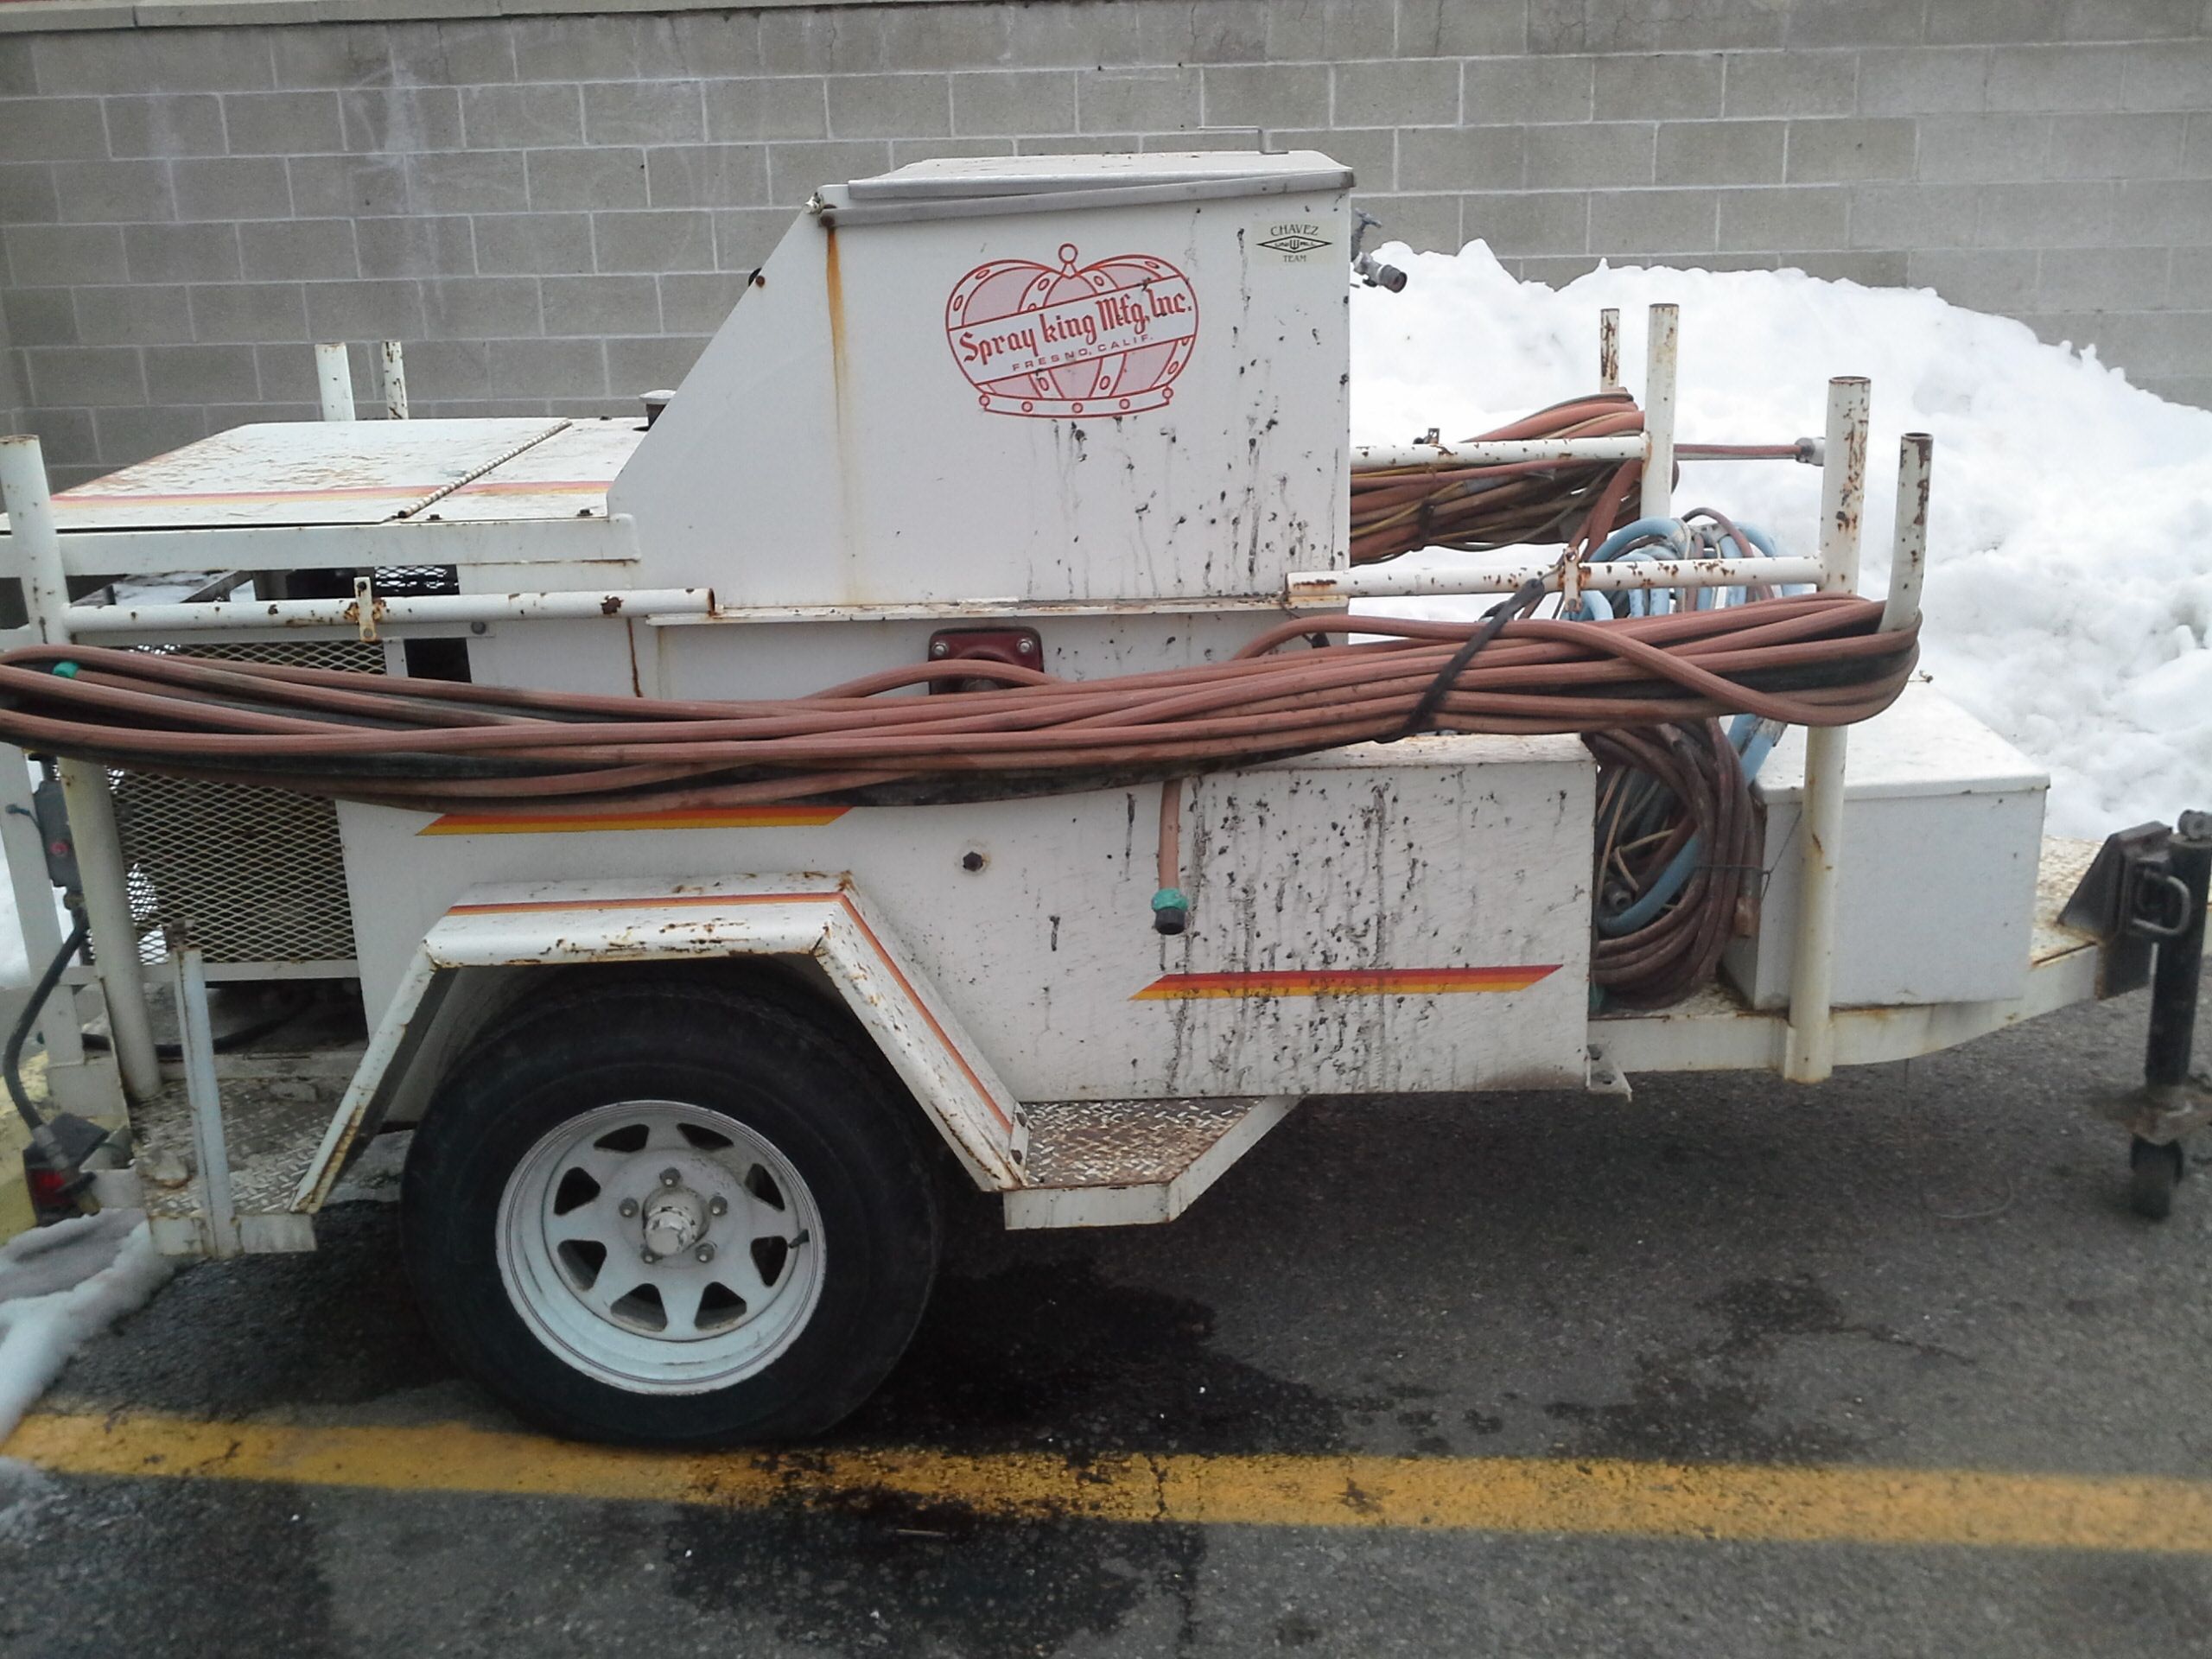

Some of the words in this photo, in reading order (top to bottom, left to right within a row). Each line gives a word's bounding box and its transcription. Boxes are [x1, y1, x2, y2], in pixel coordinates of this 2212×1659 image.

[1270, 224, 1319, 236] CHAVEZ
[1282, 254, 1306, 263] TEAM
[959, 331, 1039, 365] Spray
[1144, 288, 1192, 318] Inc.
[1012, 347, 1092, 372] FRESNO,
[1097, 334, 1154, 353] CALIF.
